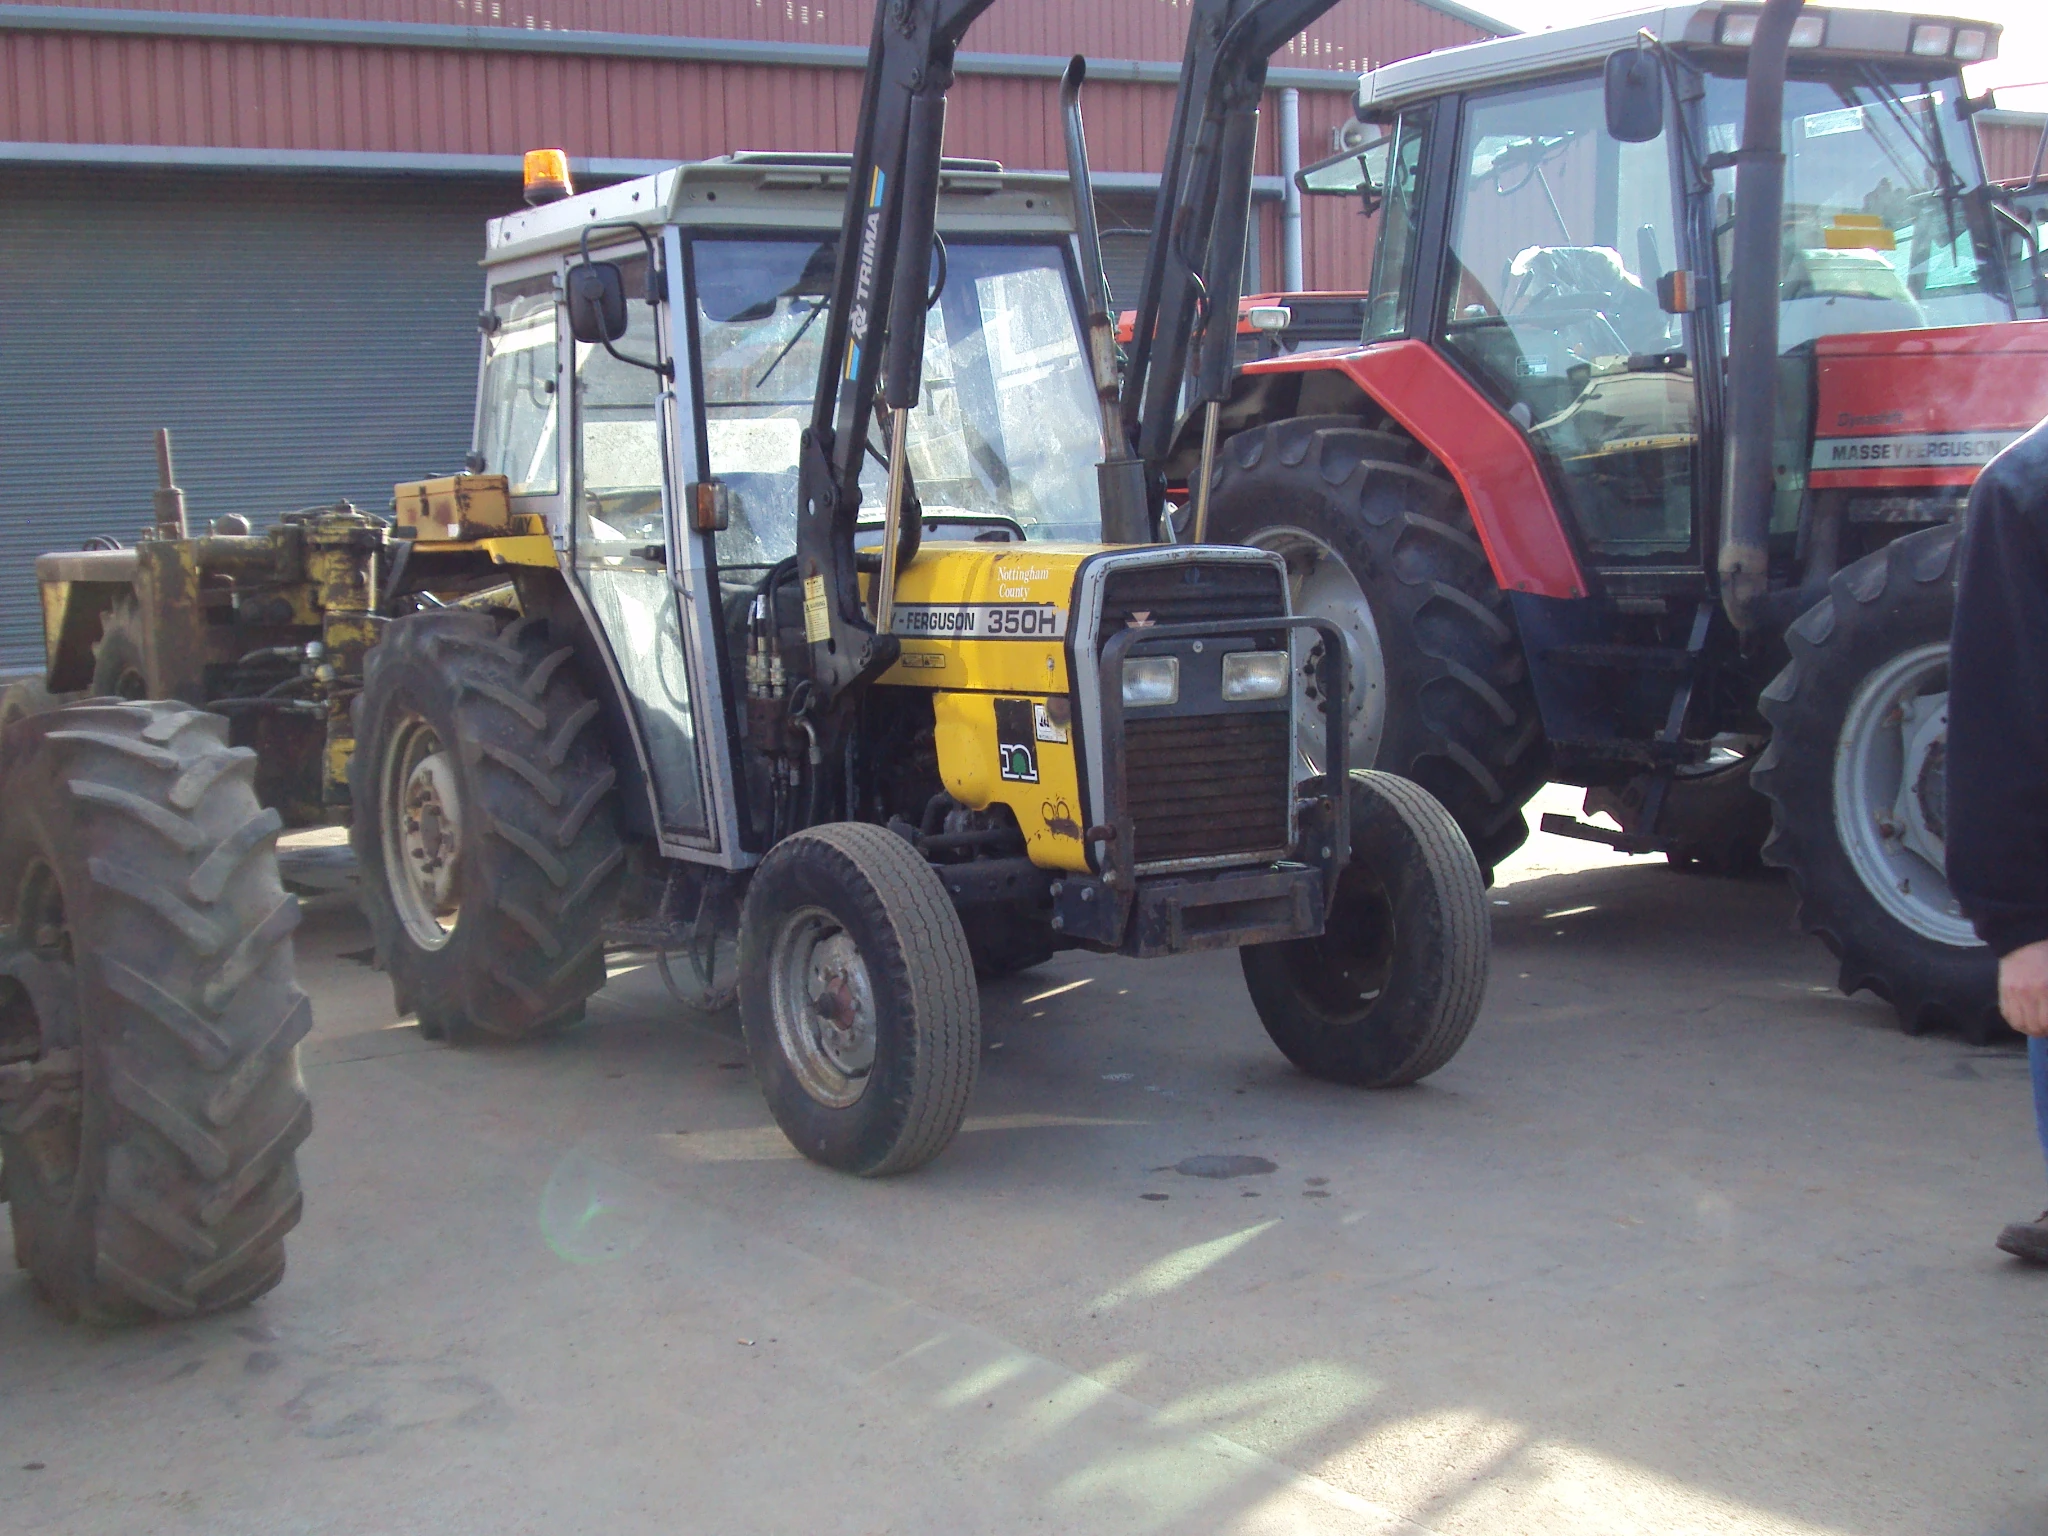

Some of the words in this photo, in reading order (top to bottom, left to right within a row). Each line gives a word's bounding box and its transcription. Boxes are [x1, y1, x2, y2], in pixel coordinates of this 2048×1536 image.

[857, 212, 880, 300] TRIMA
[1831, 443, 1903, 461] MASSEY
[997, 565, 1049, 584] Nottingham
[999, 583, 1031, 602] County
[906, 611, 975, 631] FERGUSON
[987, 609, 1056, 634] 350H
